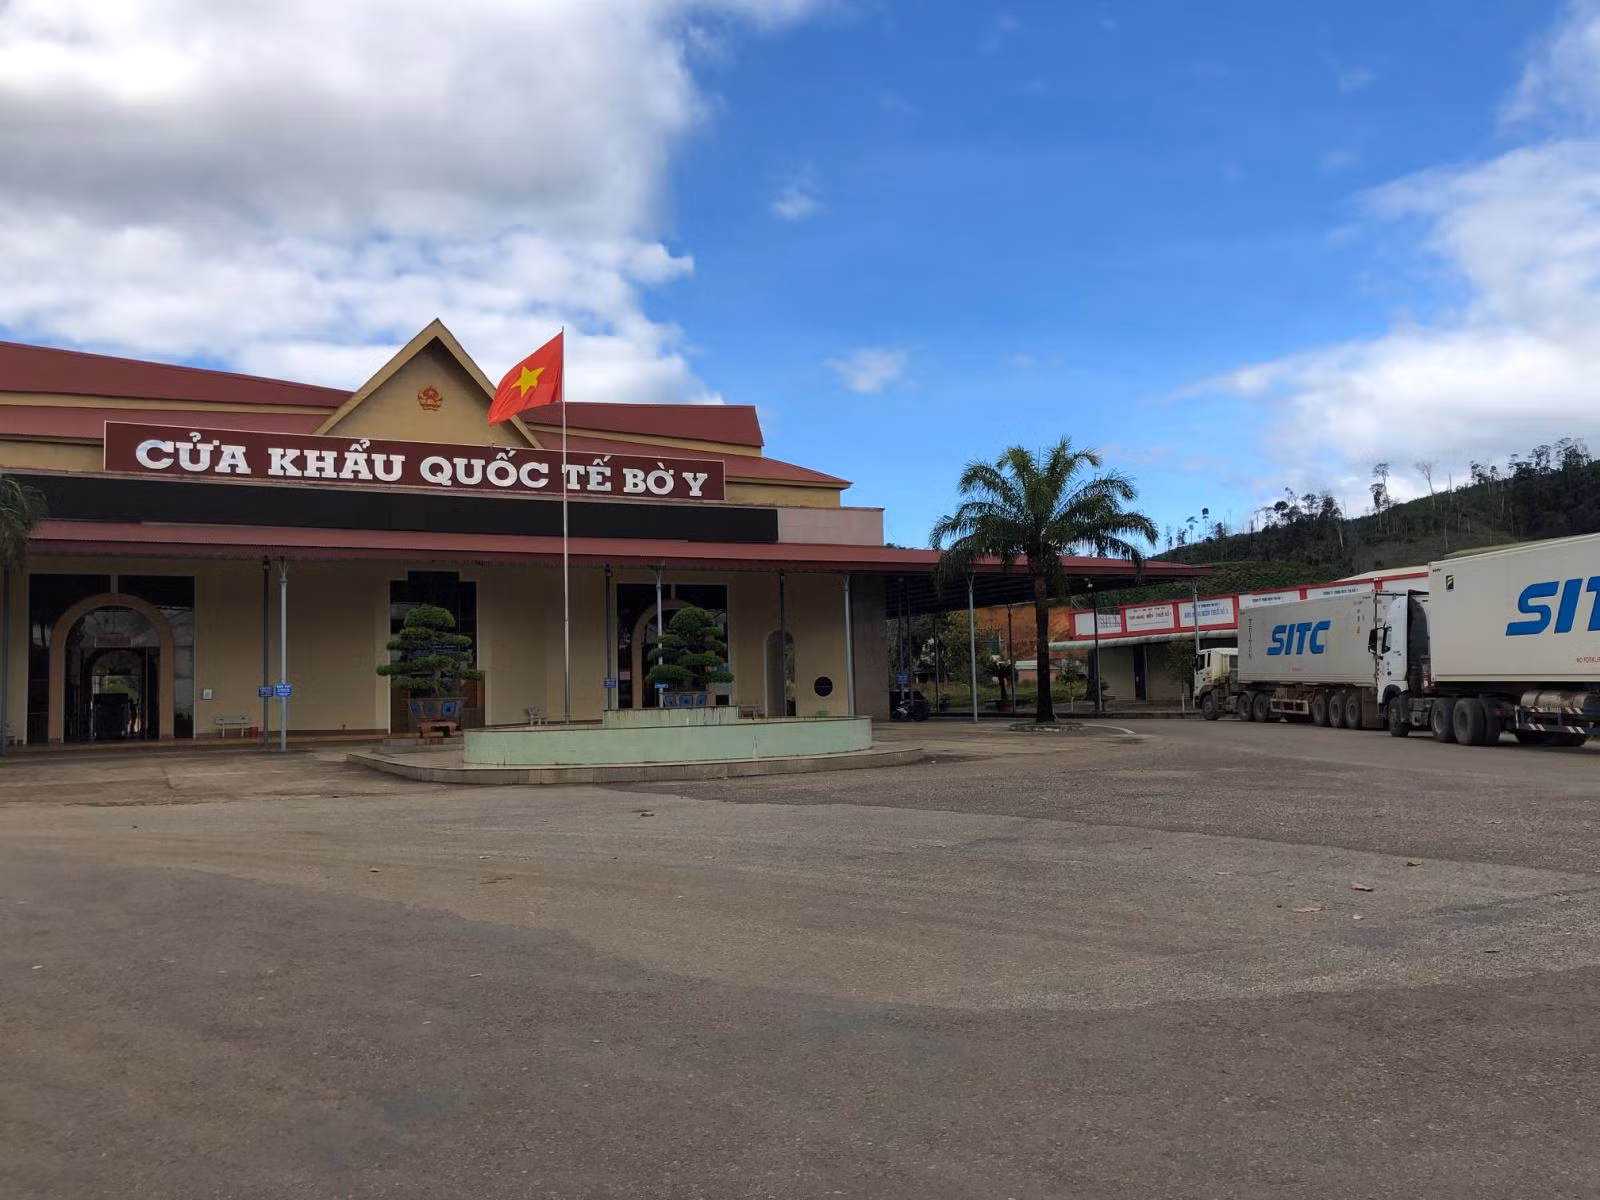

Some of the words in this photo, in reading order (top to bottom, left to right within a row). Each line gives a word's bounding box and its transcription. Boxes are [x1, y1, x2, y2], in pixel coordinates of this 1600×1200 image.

[135, 432, 251, 474] CỬA
[268, 439, 405, 481] KHẨU
[420, 450, 549, 488] QUỐC
[562, 455, 611, 491] TẾ
[623, 462, 674, 495] BỜ
[682, 472, 708, 496] Y
[1266, 620, 1331, 655] SITC
